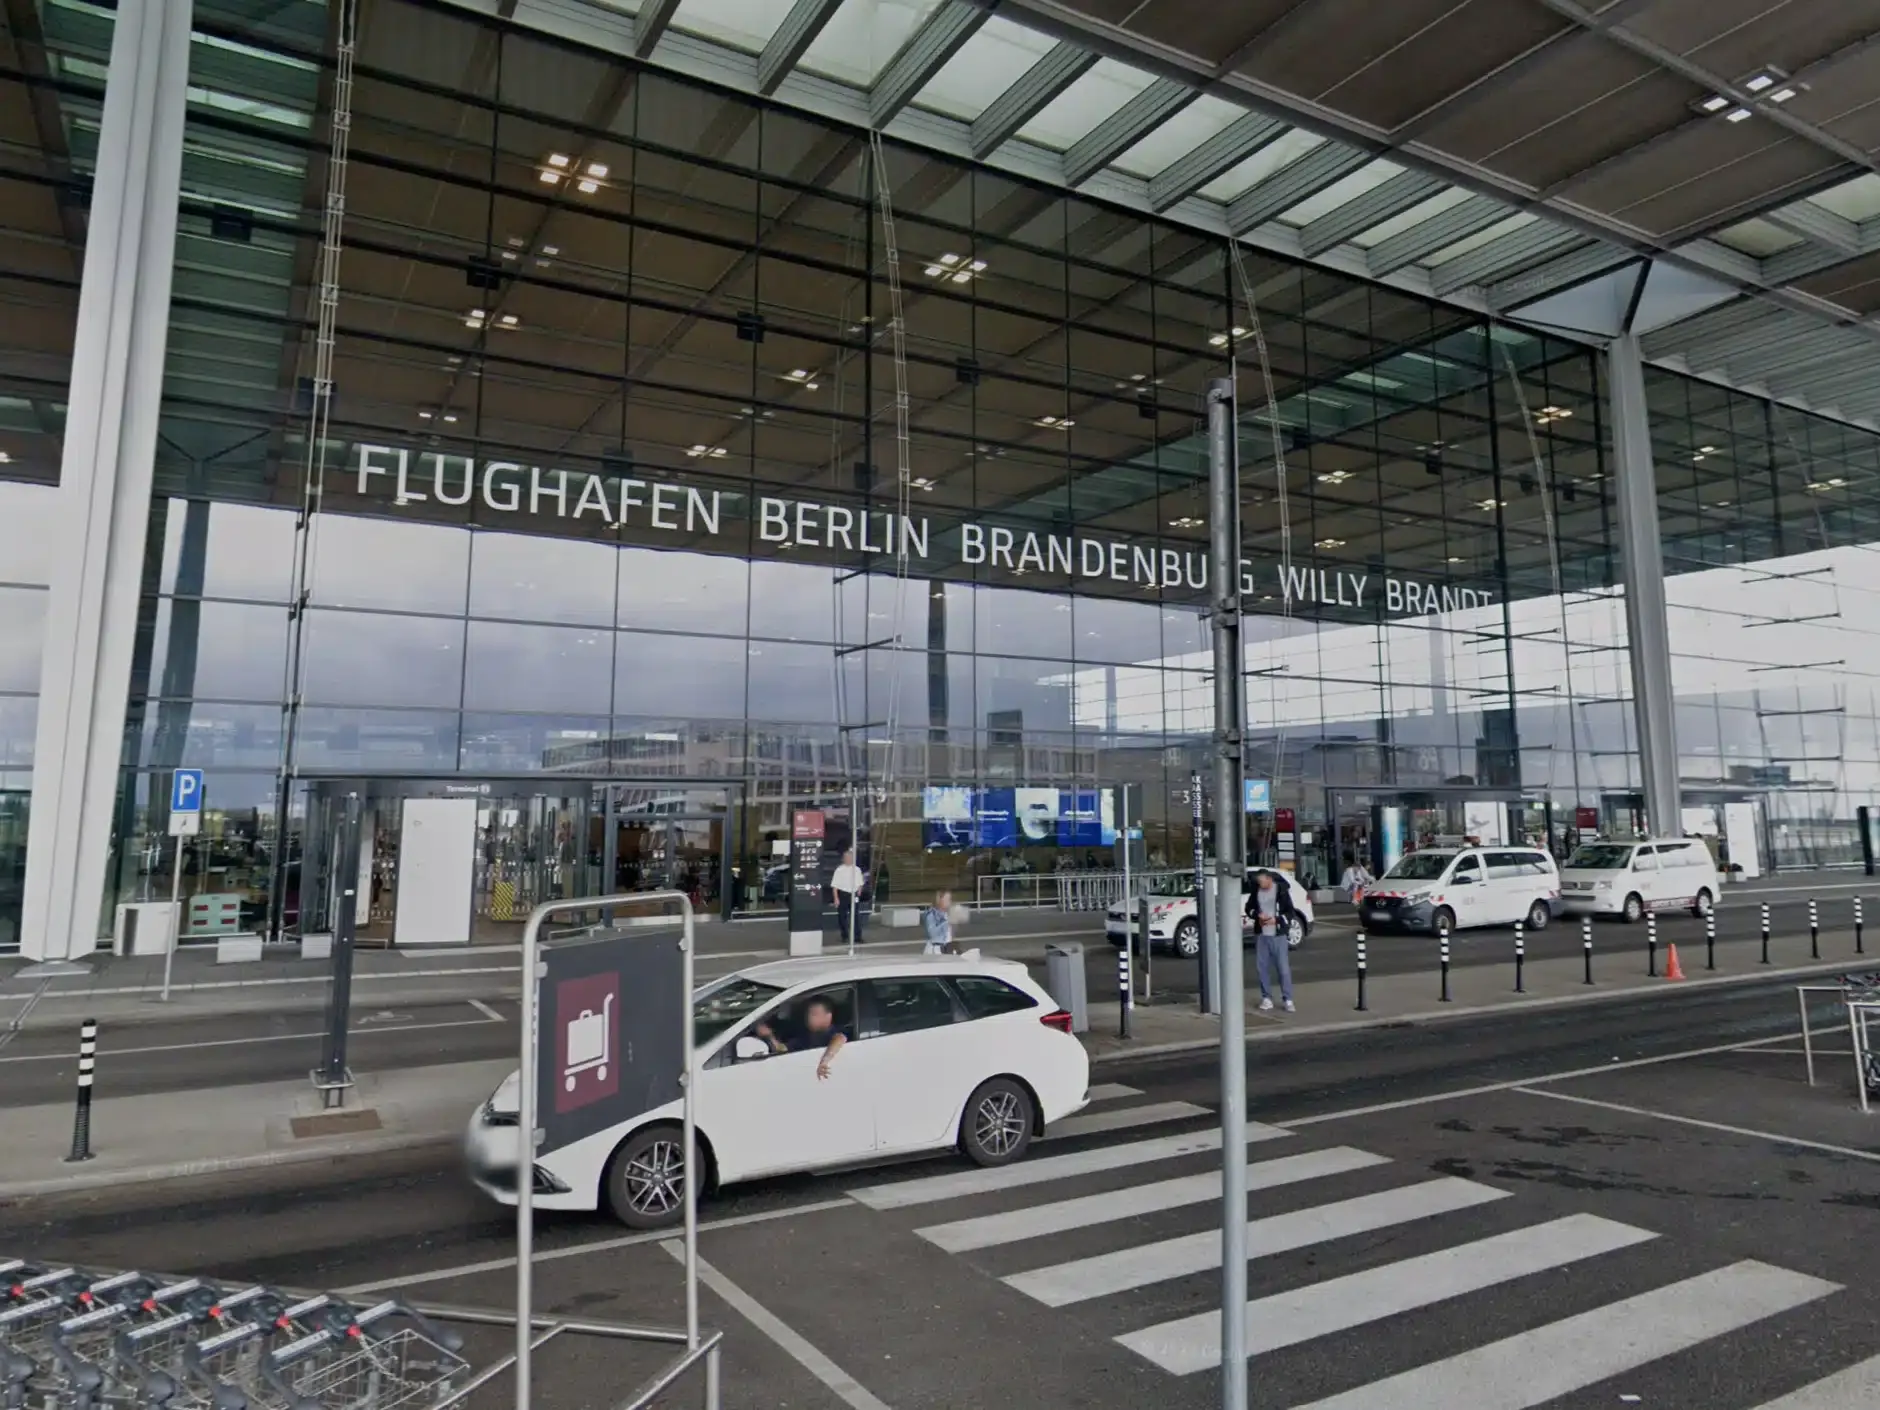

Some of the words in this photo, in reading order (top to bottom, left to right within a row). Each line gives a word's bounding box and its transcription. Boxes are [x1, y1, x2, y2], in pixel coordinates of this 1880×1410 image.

[357, 443, 721, 536] FLUGHAFEN
[758, 497, 930, 559] BERLIN
[961, 523, 1254, 595] BRANDENBUG
[1277, 564, 1368, 608] WILLY
[178, 773, 197, 807] P
